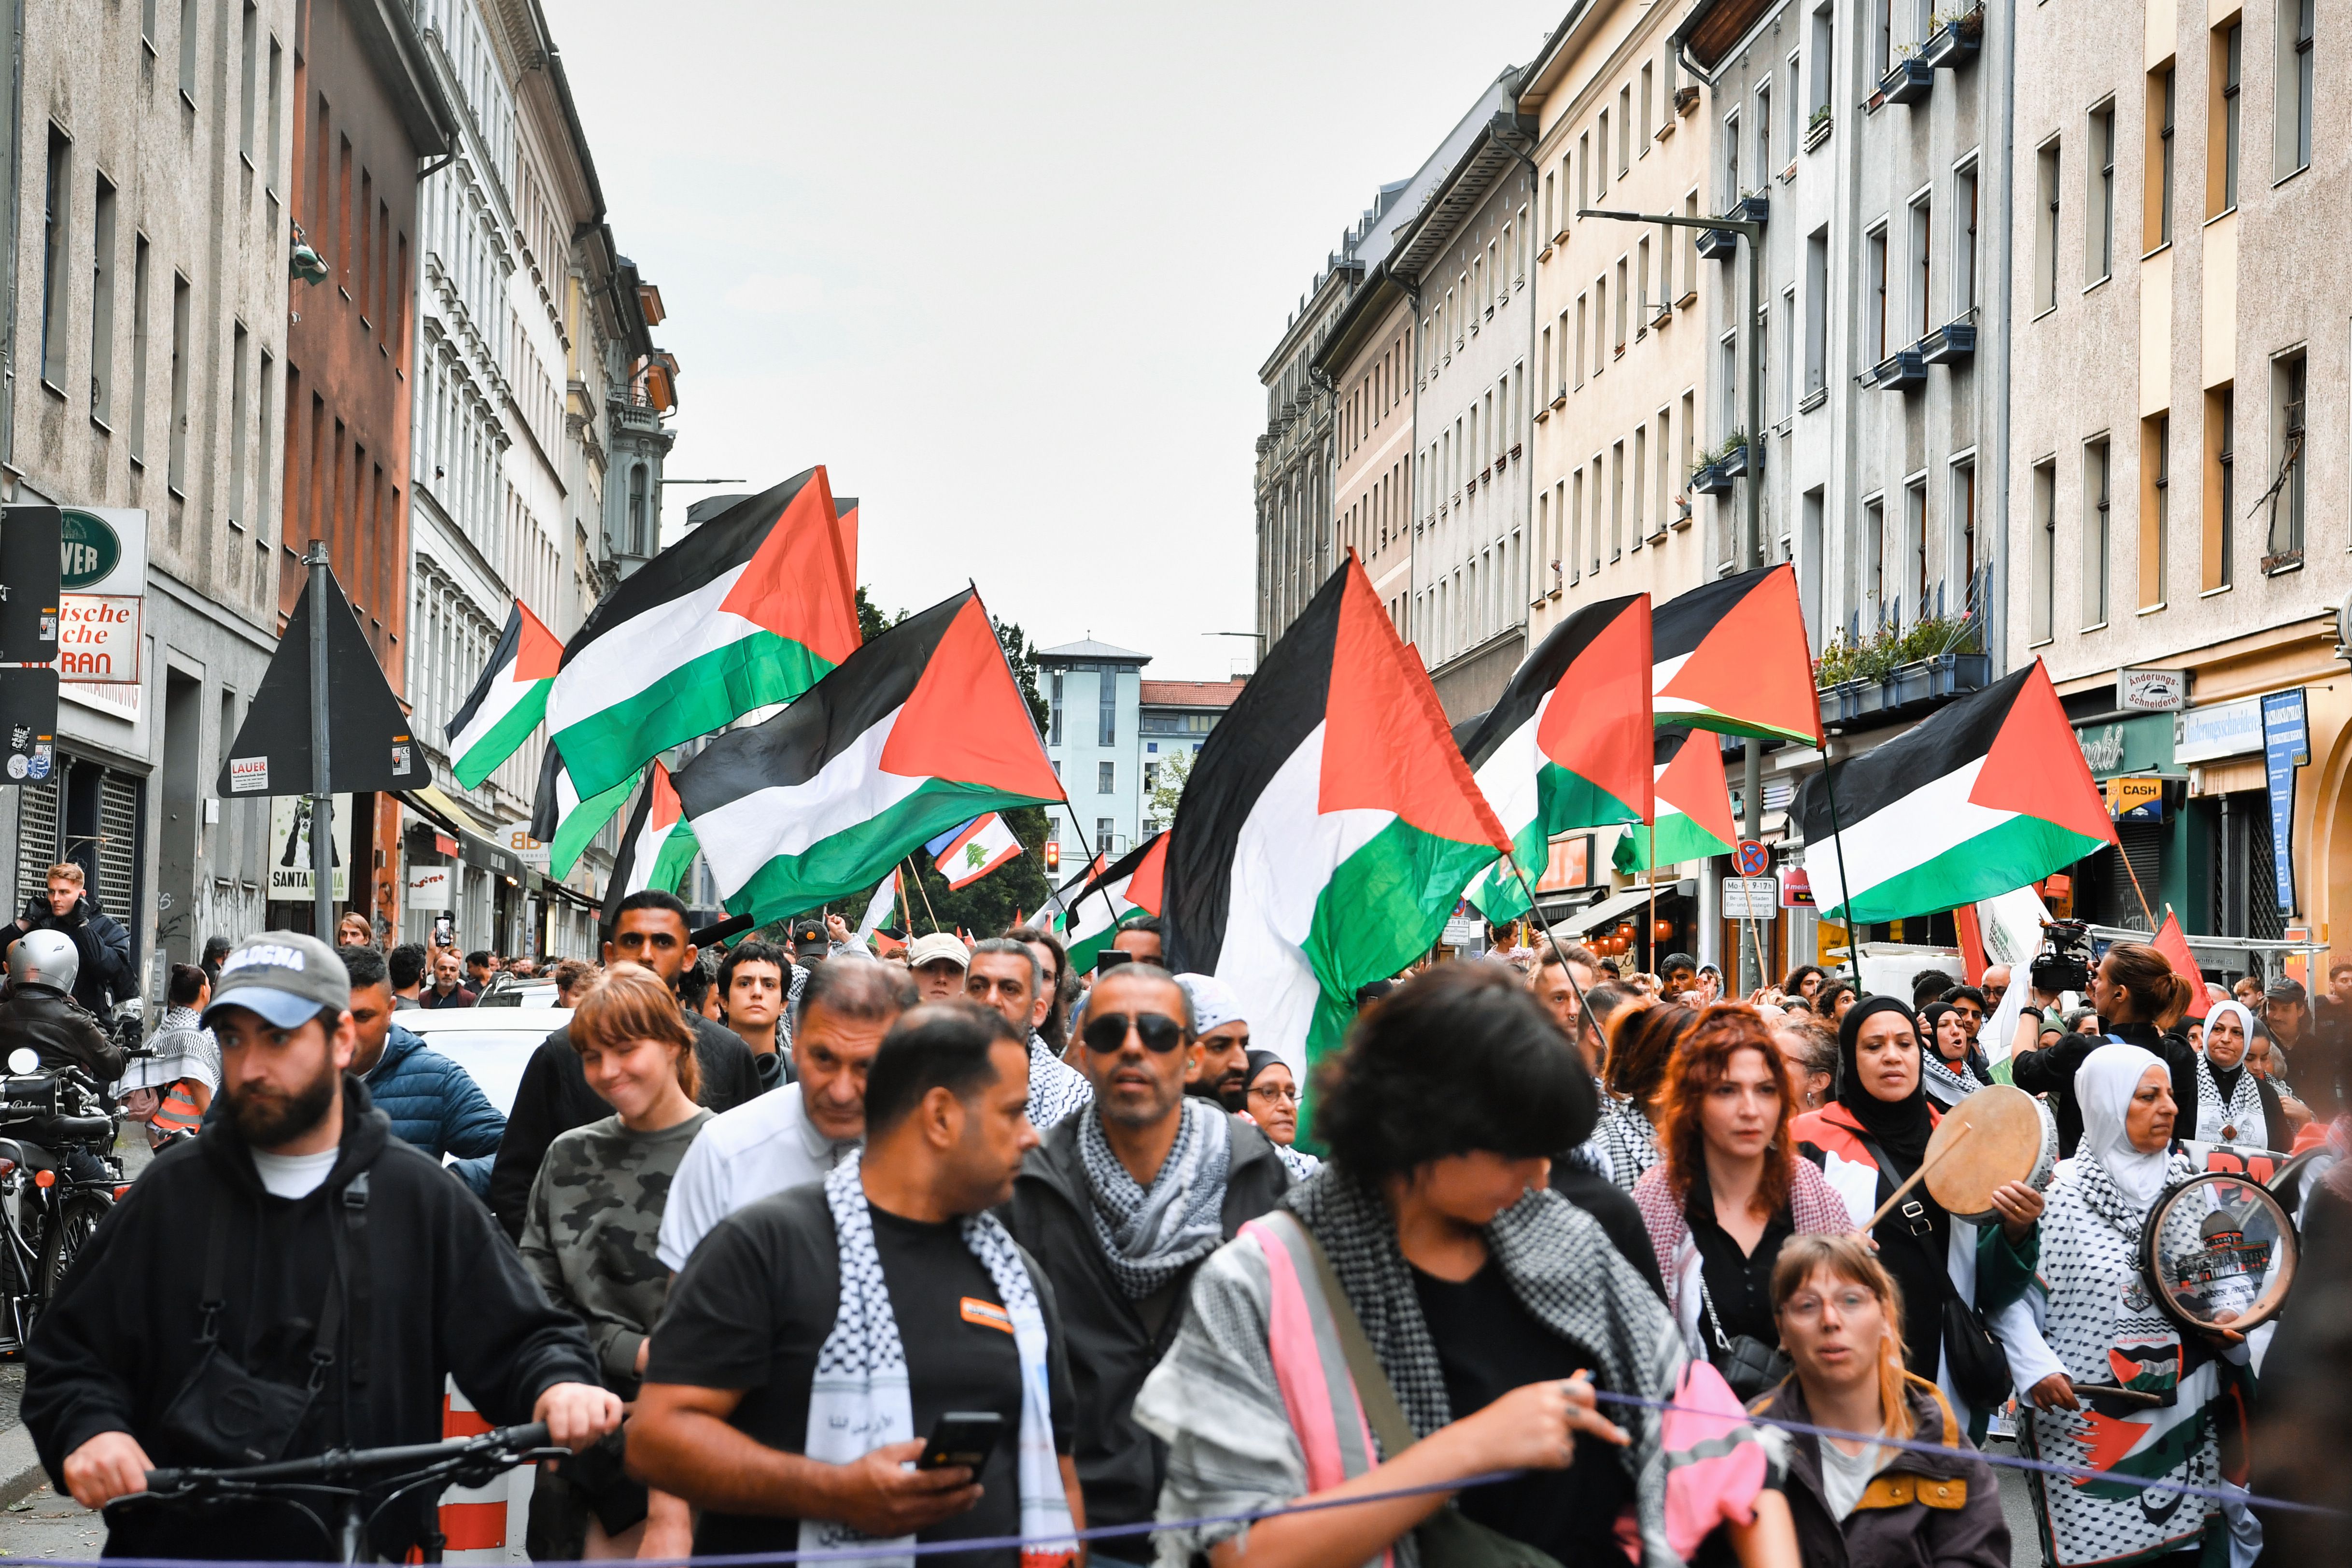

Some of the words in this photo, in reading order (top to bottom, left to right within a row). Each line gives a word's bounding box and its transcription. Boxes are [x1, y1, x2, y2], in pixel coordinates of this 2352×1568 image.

[61, 542, 98, 575] VER
[60, 602, 129, 623] ische
[62, 624, 108, 643] che
[61, 652, 111, 674] RAN
[2127, 673, 2179, 687] Änderungs-
[2129, 693, 2179, 708] Schneiderei
[232, 762, 266, 774] LAUER
[2108, 785, 2118, 795] CASH
[2123, 786, 2156, 795] CASH
[273, 871, 344, 888] SANTAMIA
